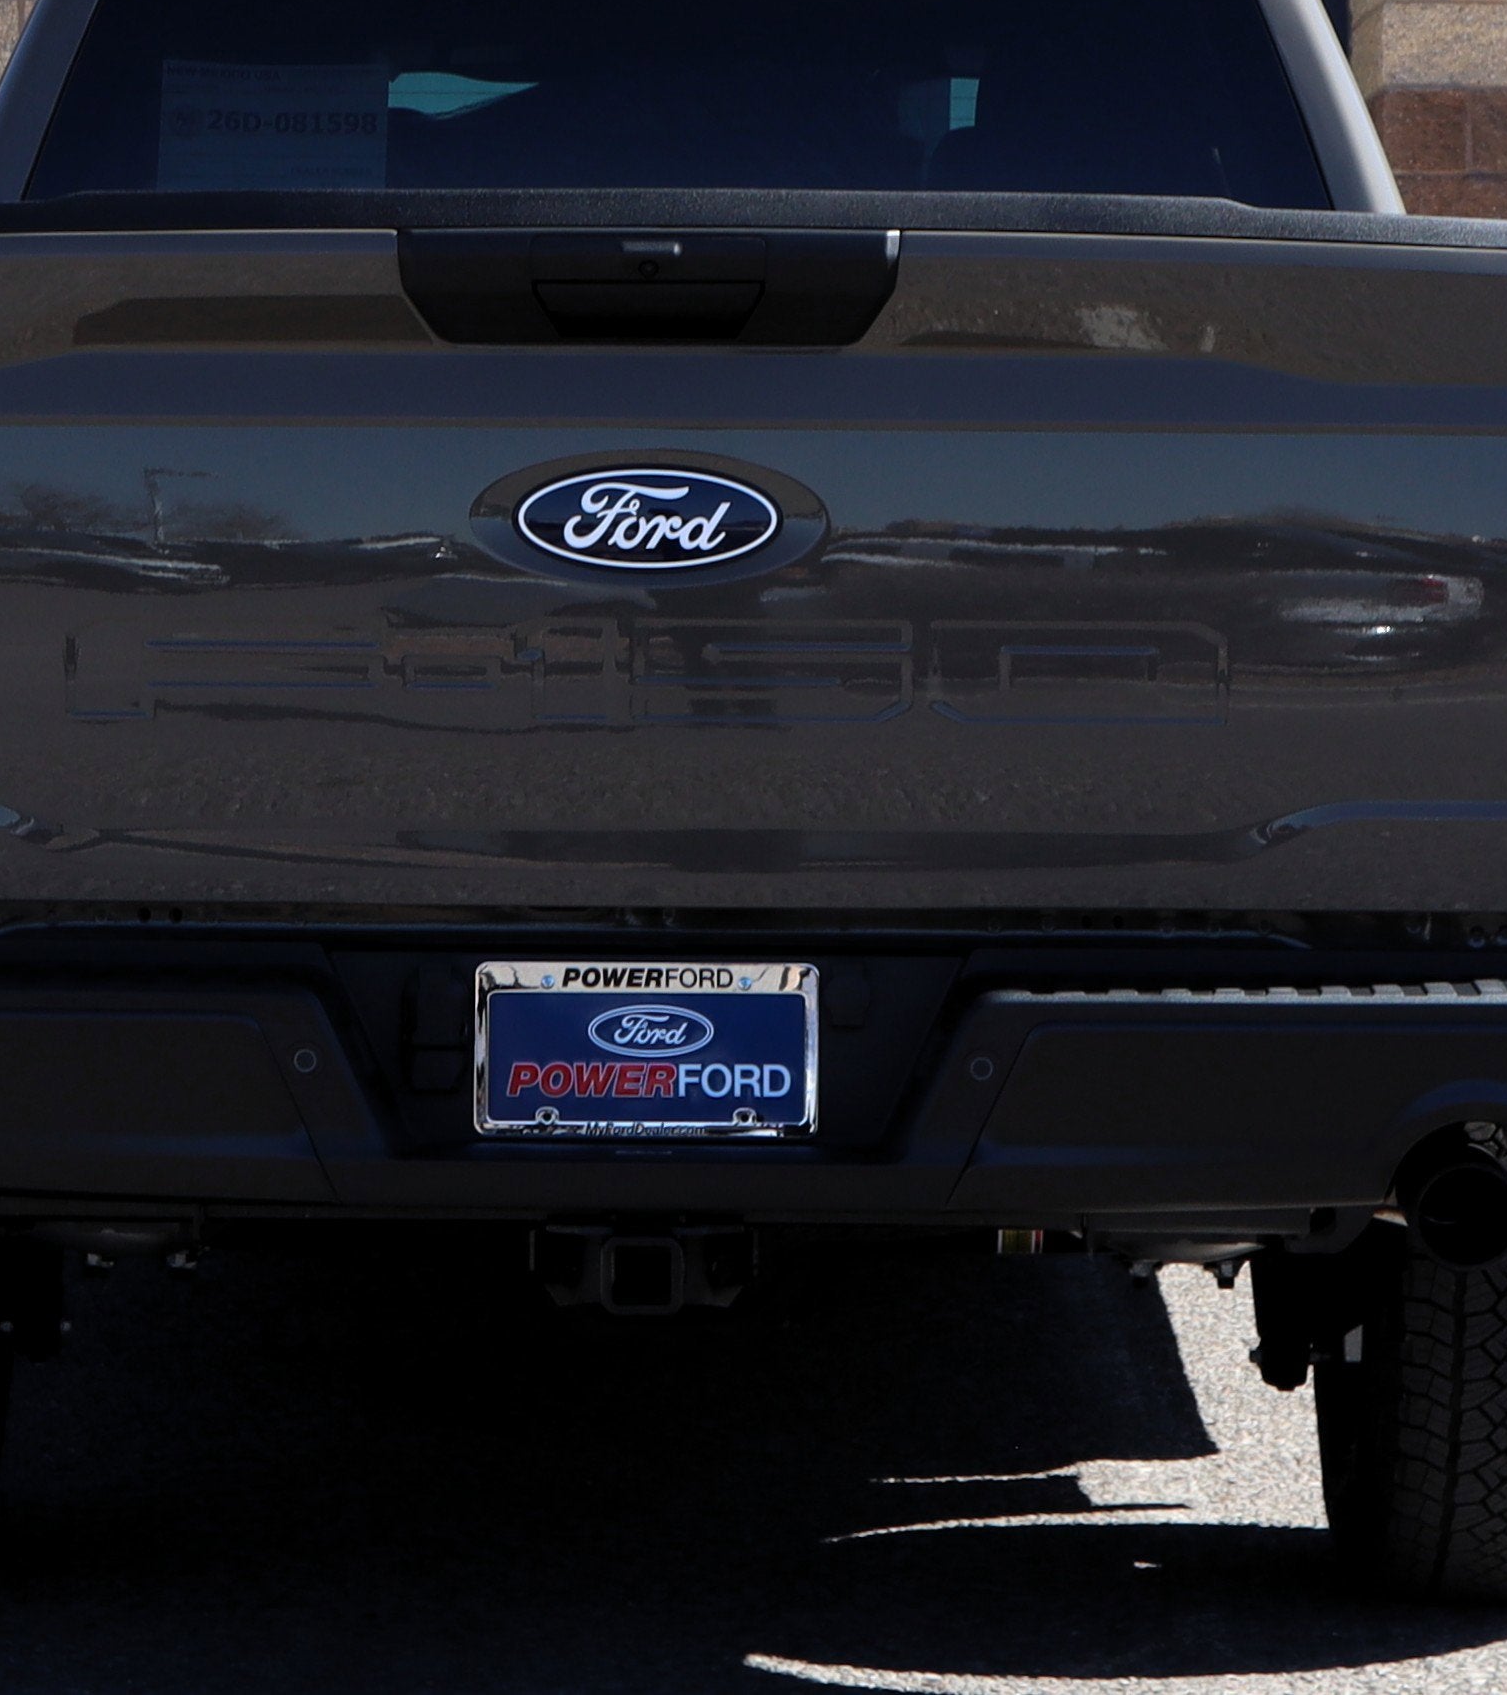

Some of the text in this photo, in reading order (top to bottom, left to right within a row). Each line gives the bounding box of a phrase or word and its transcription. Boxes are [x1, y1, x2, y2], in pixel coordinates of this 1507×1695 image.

[207, 110, 378, 134] 26D-081598
[563, 481, 731, 551] Ford
[561, 967, 734, 989] POWERFORD
[613, 1012, 688, 1046] Ford
[506, 1061, 792, 1099] POWERFORD
